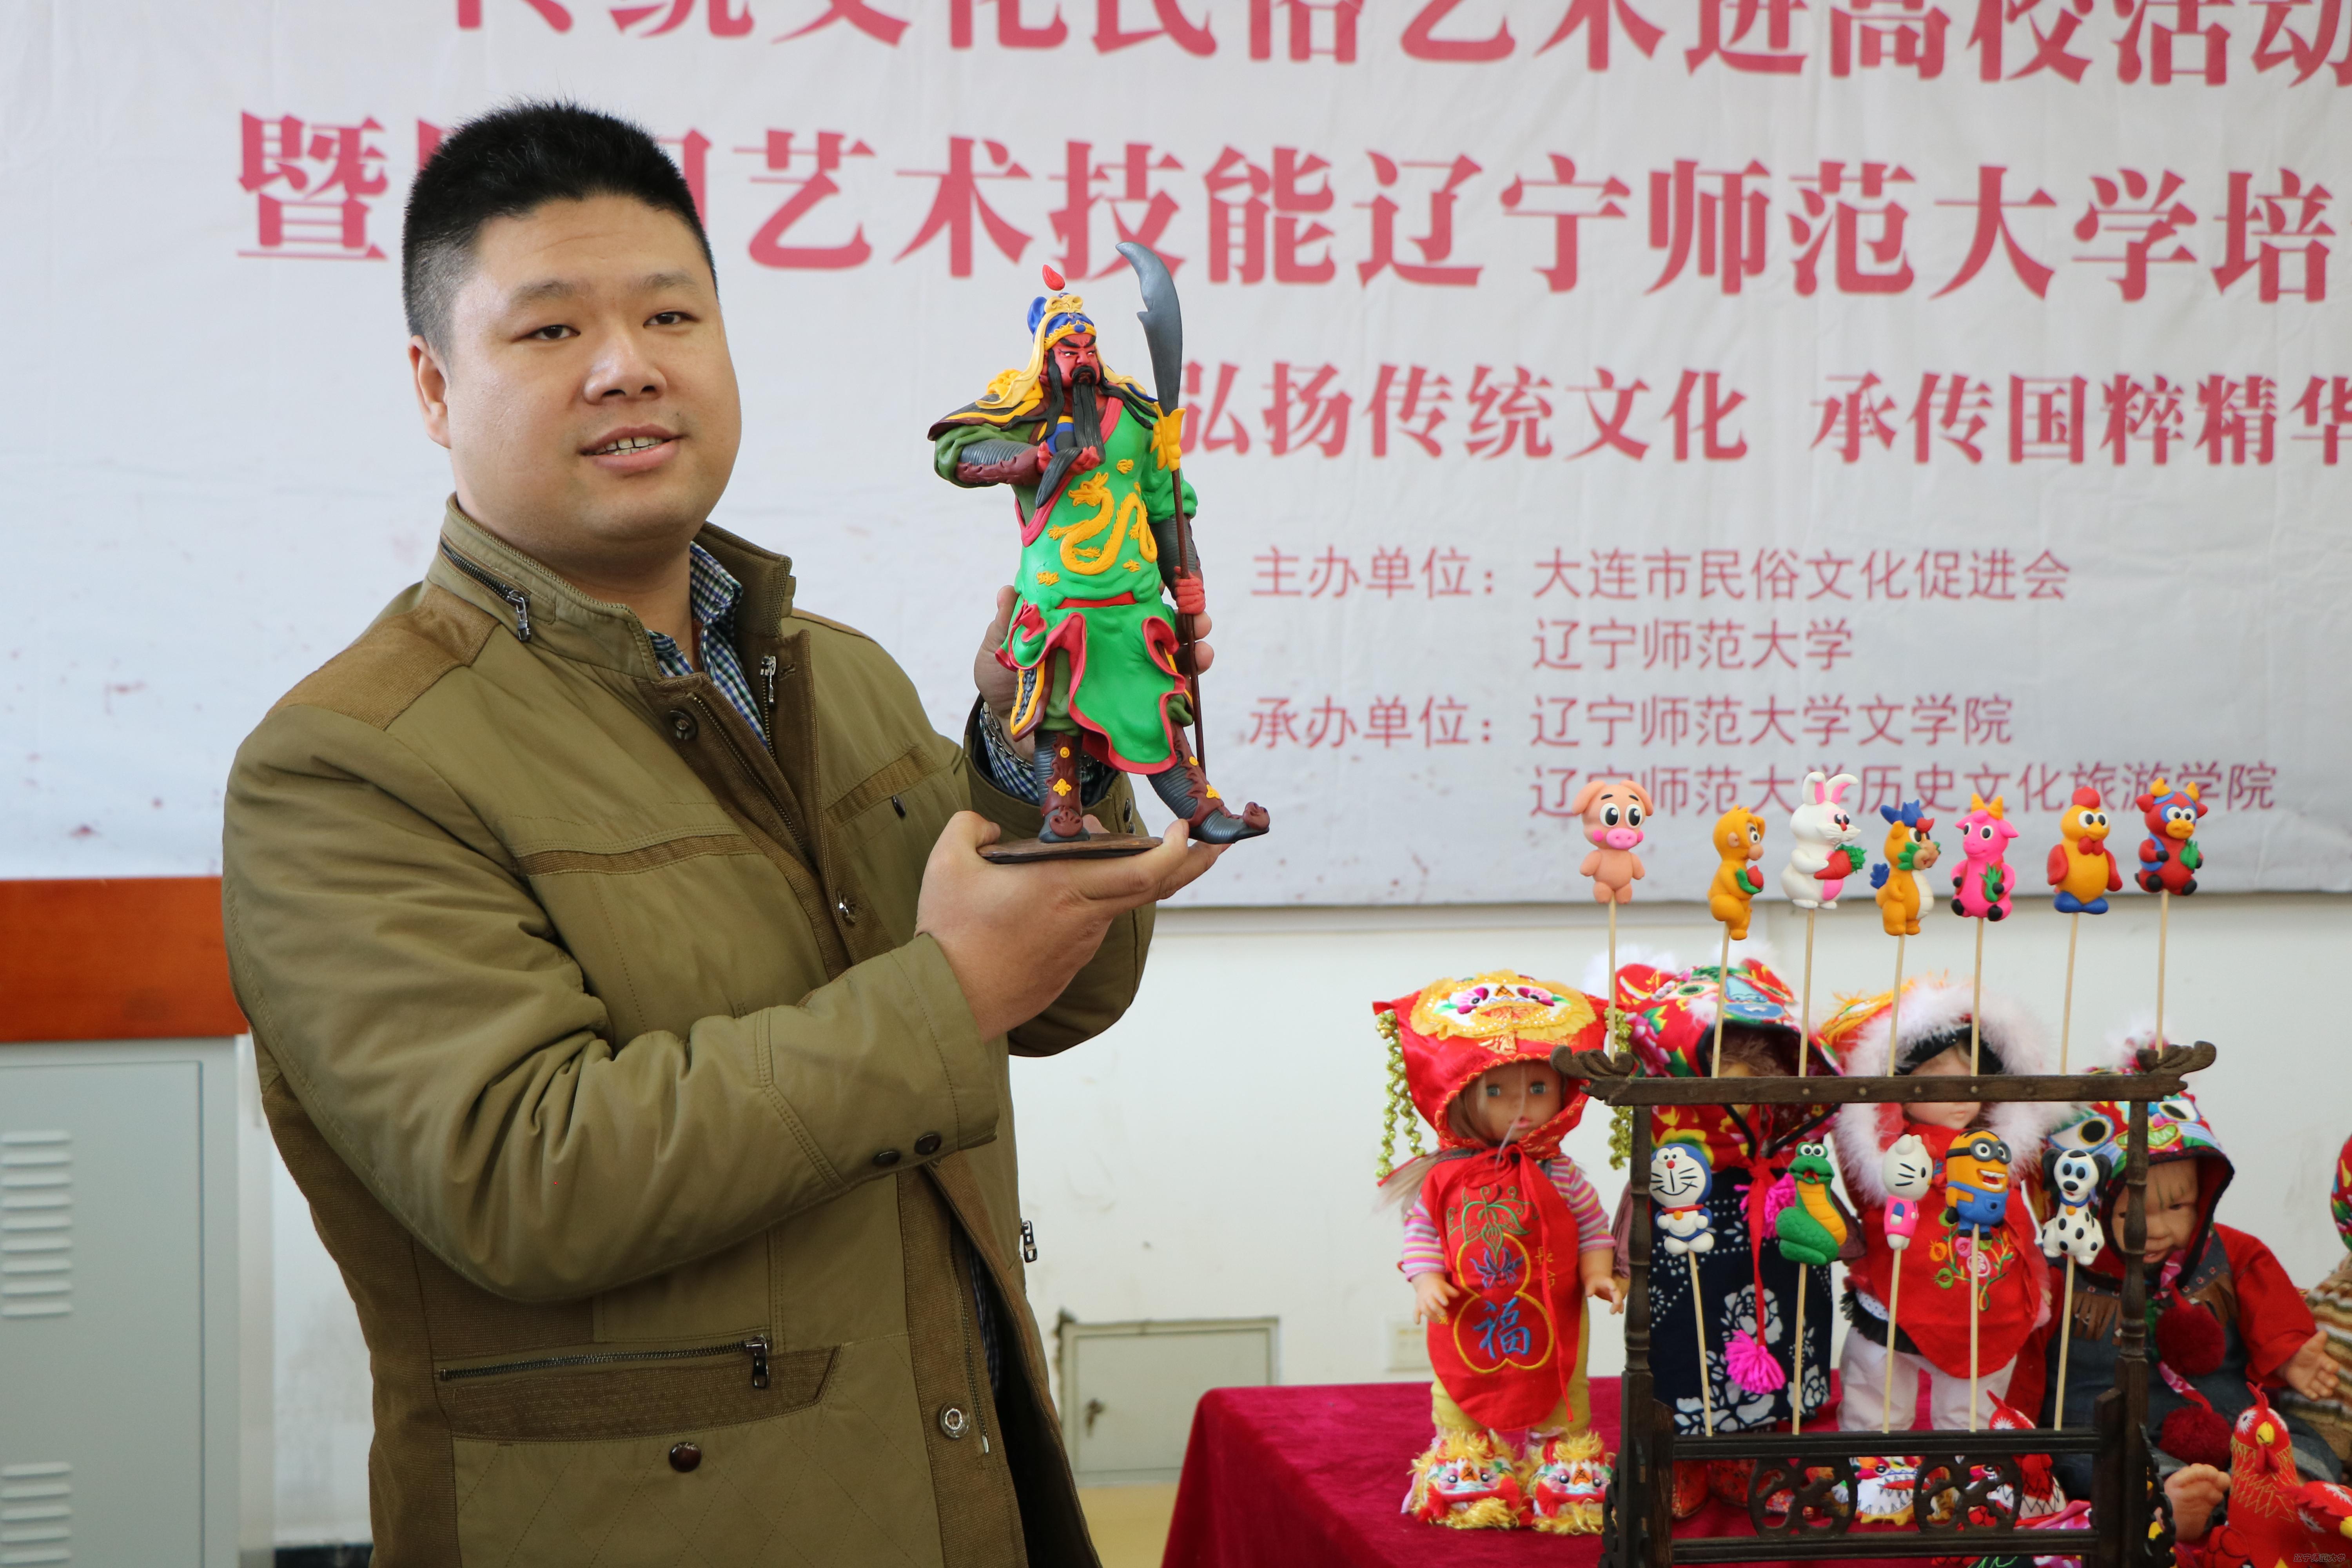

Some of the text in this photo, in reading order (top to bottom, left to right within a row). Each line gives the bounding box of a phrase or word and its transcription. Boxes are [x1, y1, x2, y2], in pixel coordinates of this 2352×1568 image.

[236, 111, 2337, 304] 暨艺术技能辽宁师范大学培
[1181, 360, 2352, 467] 弘扬传统文化 承传国粹精华
[1251, 544, 2070, 601] 主办单位： 大连市民俗文化促进会
[1532, 618, 1853, 671] 辽宁师范大学
[1248, 693, 2013, 750] 承办单位： 辽宁师范大学文学院
[1530, 760, 2277, 818] 辽师范大历史文化旅游学院
[1473, 1296, 1531, 1359] 福
